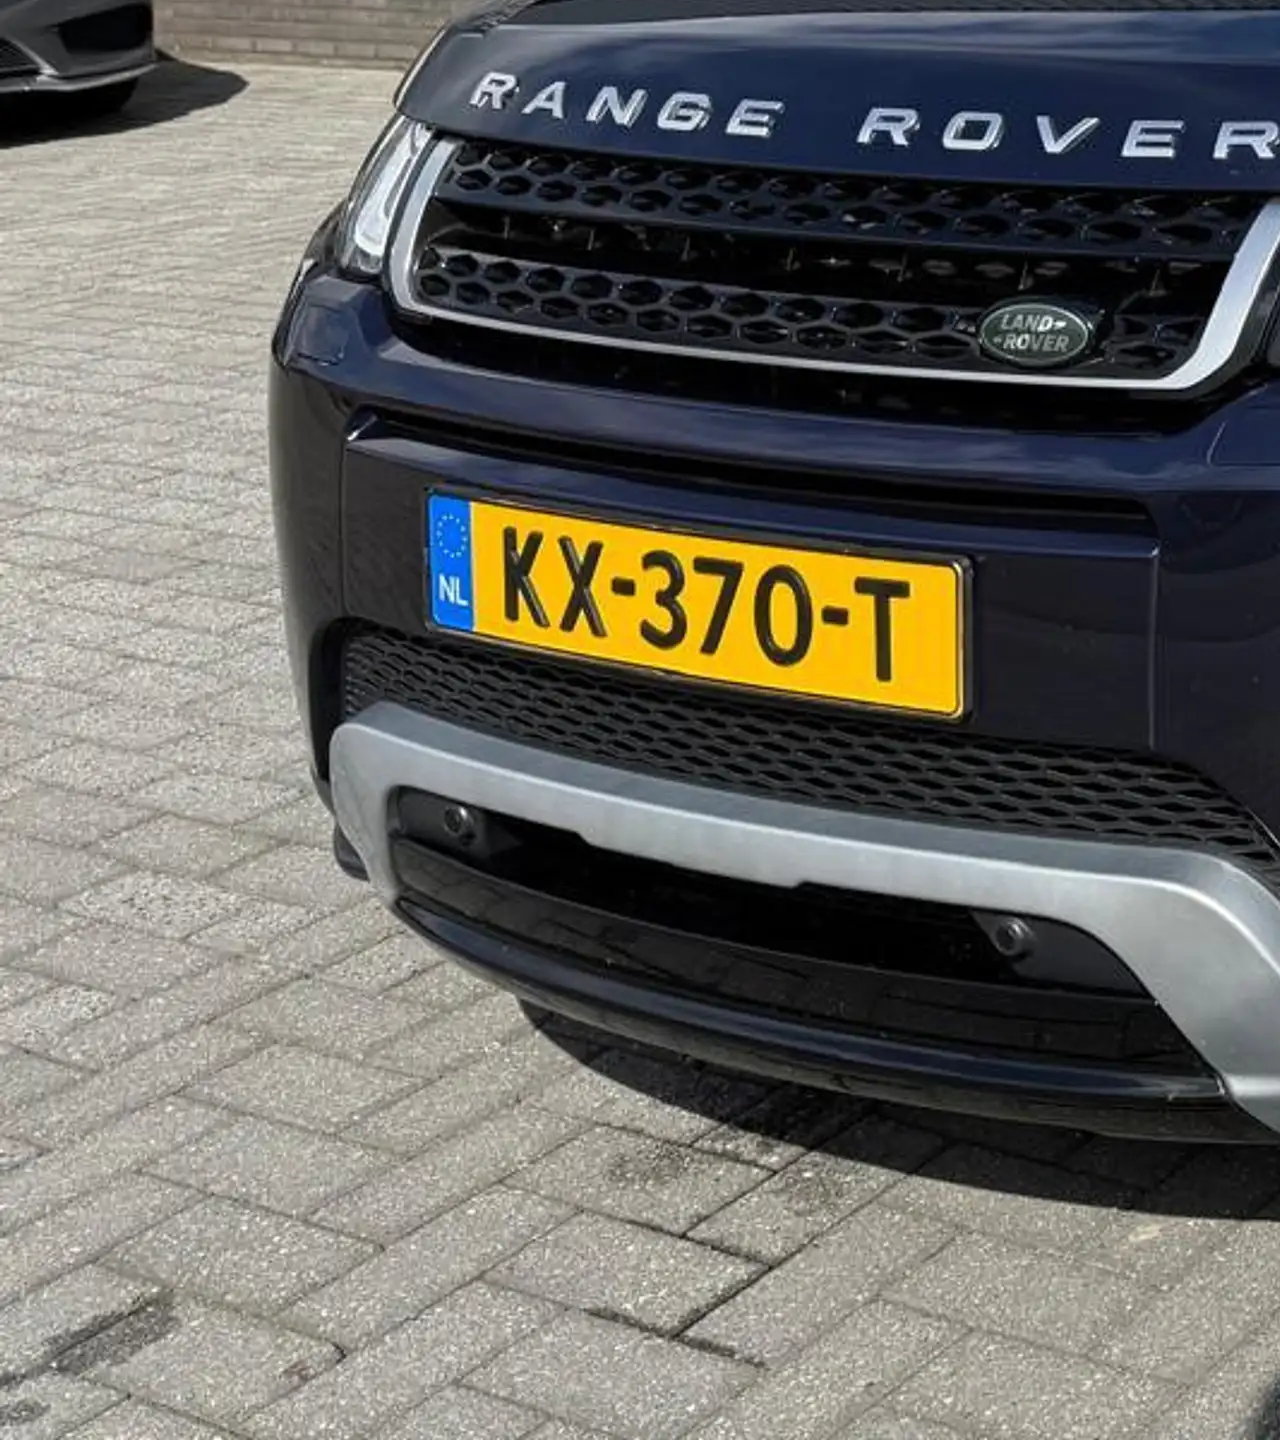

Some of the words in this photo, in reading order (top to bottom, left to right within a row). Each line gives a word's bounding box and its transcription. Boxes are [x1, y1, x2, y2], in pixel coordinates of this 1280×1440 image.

[470, 71, 784, 138] RANGE
[1001, 313, 1054, 333] LAND
[1002, 332, 1070, 353] ROVER
[438, 574, 469, 607] NL
[502, 525, 911, 683] KX-370-T
